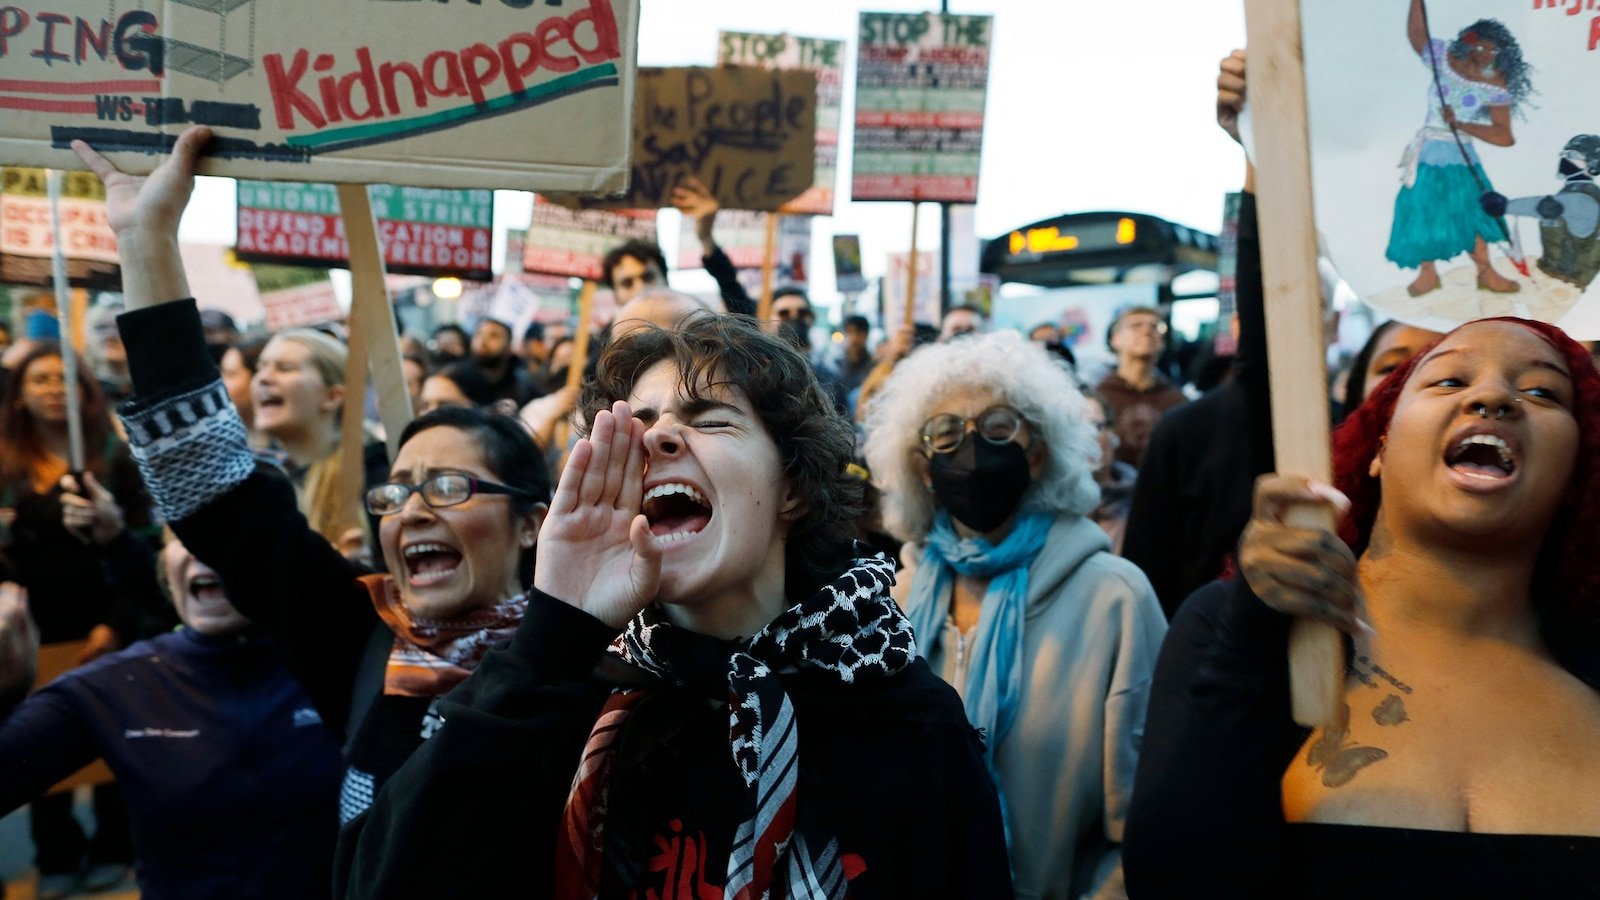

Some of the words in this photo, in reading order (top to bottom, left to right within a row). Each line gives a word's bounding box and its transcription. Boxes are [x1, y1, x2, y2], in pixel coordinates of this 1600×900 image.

[723, 33, 786, 62] STOP
[799, 38, 841, 67] THE
[862, 15, 930, 44] STOP
[942, 16, 986, 46] THE
[262, 0, 621, 130] Kidnapped
[687, 70, 807, 137] People
[710, 162, 797, 201] ICE
[238, 187, 341, 213] UNIONI
[404, 200, 491, 227] STRIKE
[238, 231, 349, 257] ACADEMI
[239, 208, 326, 233] DEFEND
[334, 214, 464, 247] ECATION
[473, 229, 490, 247] &
